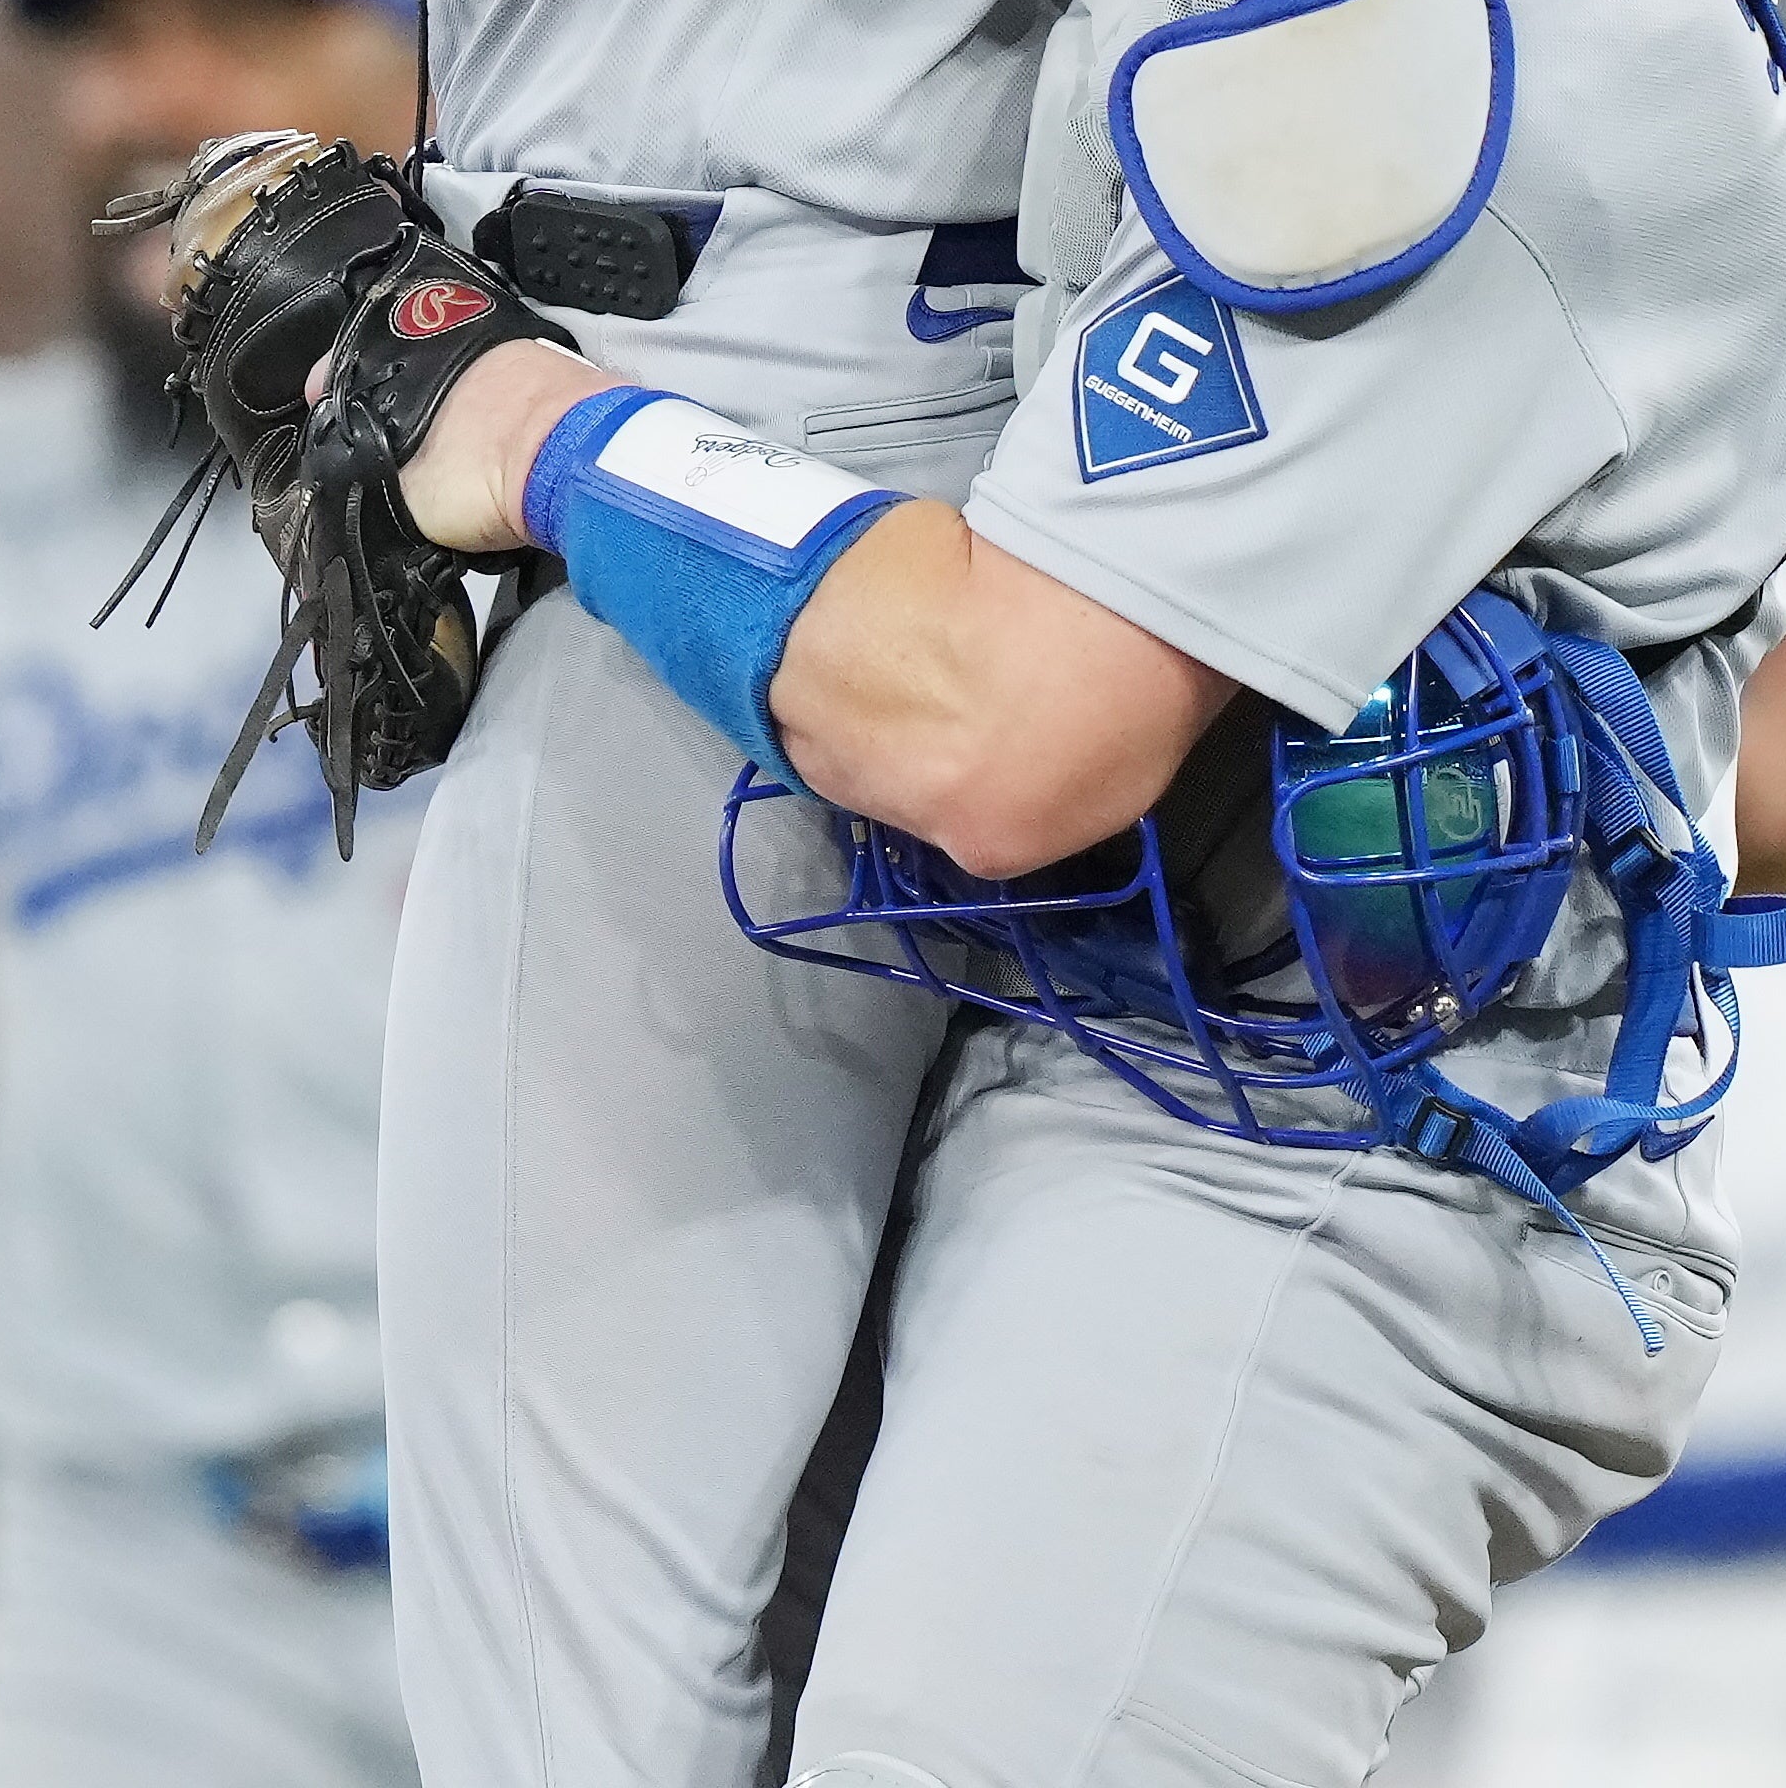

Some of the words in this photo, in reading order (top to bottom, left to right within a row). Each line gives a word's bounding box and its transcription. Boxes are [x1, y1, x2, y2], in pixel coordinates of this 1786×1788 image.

[1117, 311, 1214, 405] G
[1084, 374, 1193, 443] GUGGENHEIM
[691, 433, 805, 468] Dodgers
